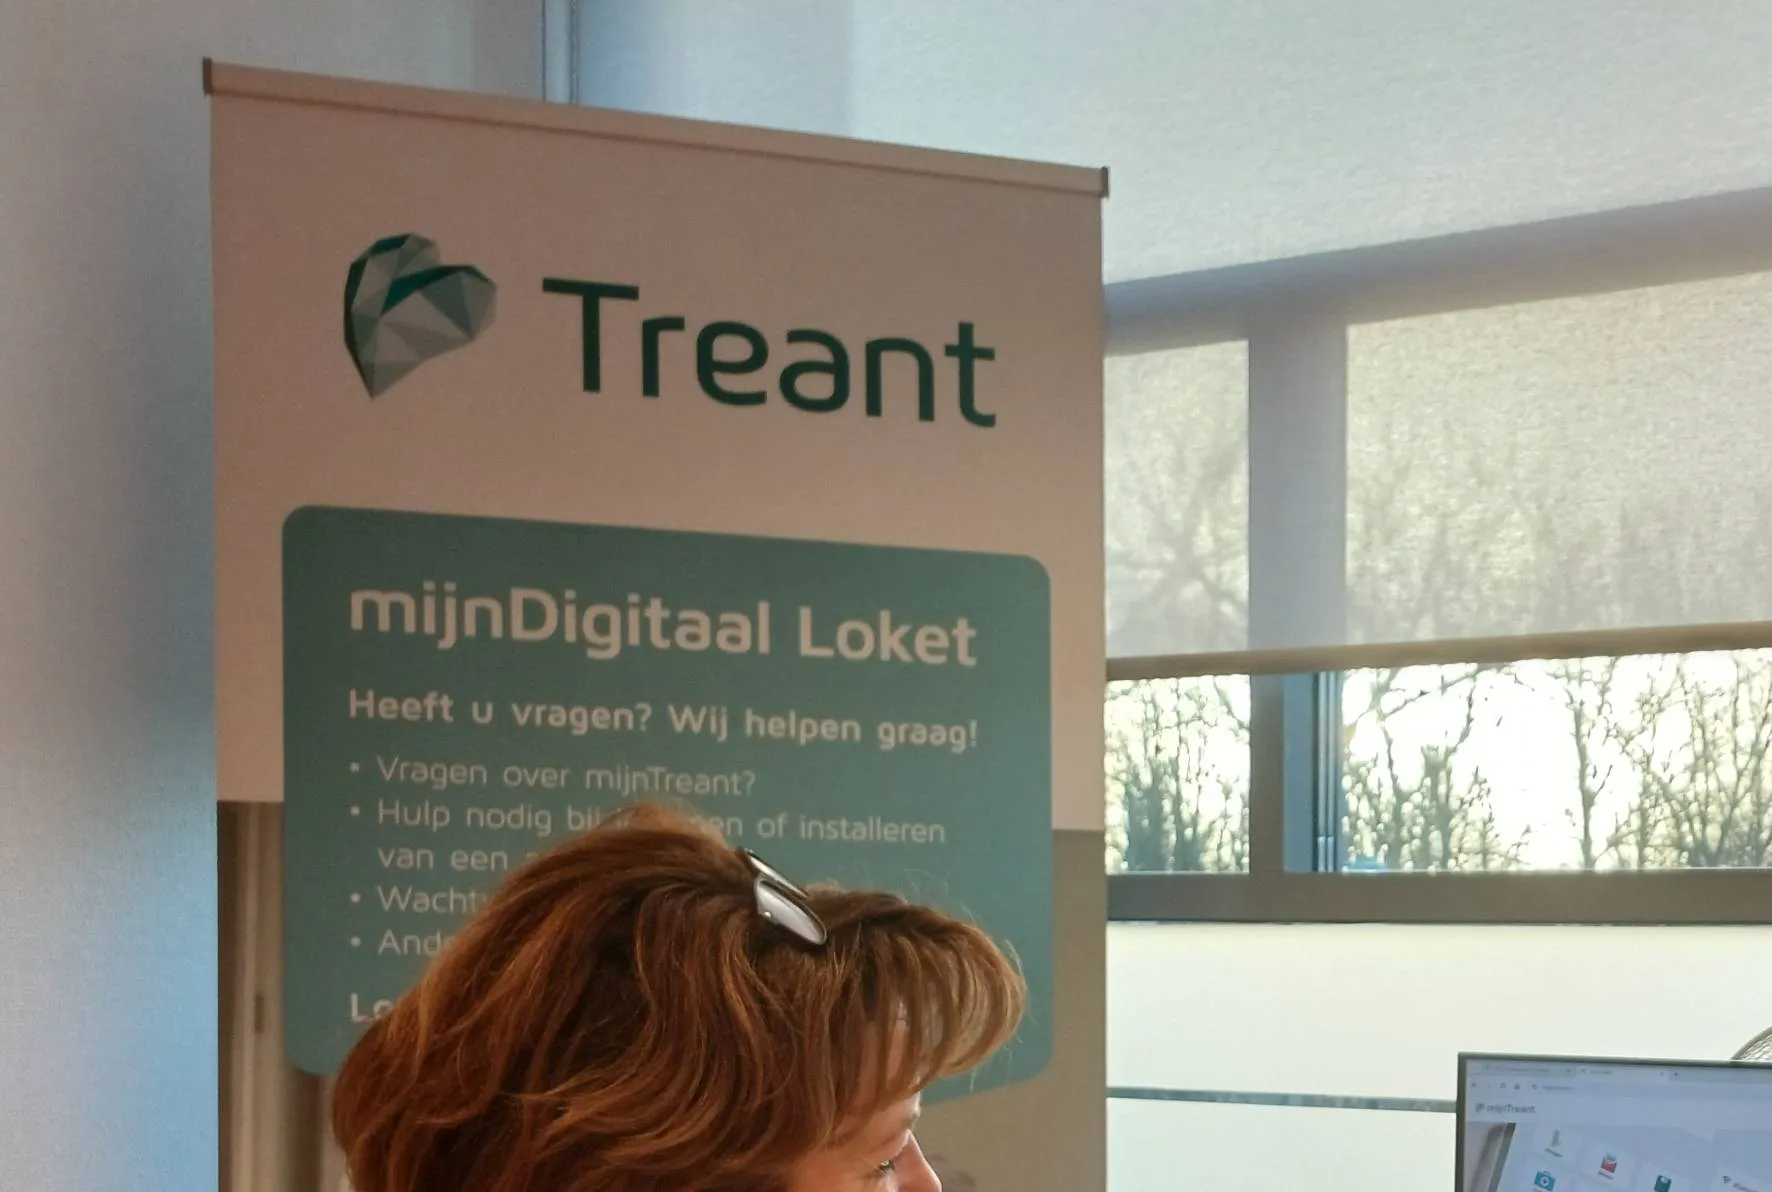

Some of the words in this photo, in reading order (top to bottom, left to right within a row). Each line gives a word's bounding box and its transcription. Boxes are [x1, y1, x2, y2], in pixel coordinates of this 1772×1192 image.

[542, 277, 997, 428] Treant
[349, 579, 771, 660] mijnDigitaal
[800, 605, 978, 667] Loket
[348, 690, 454, 723] Heeft
[472, 701, 493, 725] u
[512, 703, 653, 738] vragen?
[669, 705, 730, 743] Wij
[745, 710, 861, 746] helpen
[878, 718, 979, 753] graag!
[376, 755, 488, 789] Vragen
[503, 767, 569, 790] over
[585, 765, 756, 799] mijnTreant?
[377, 798, 451, 832] Hulp
[466, 804, 552, 838] nodig
[758, 814, 786, 838] of
[800, 814, 945, 844] installeren
[377, 848, 435, 870] van
[451, 850, 508, 871] een
[377, 885, 489, 913] Wacht
[377, 929, 456, 957] And
